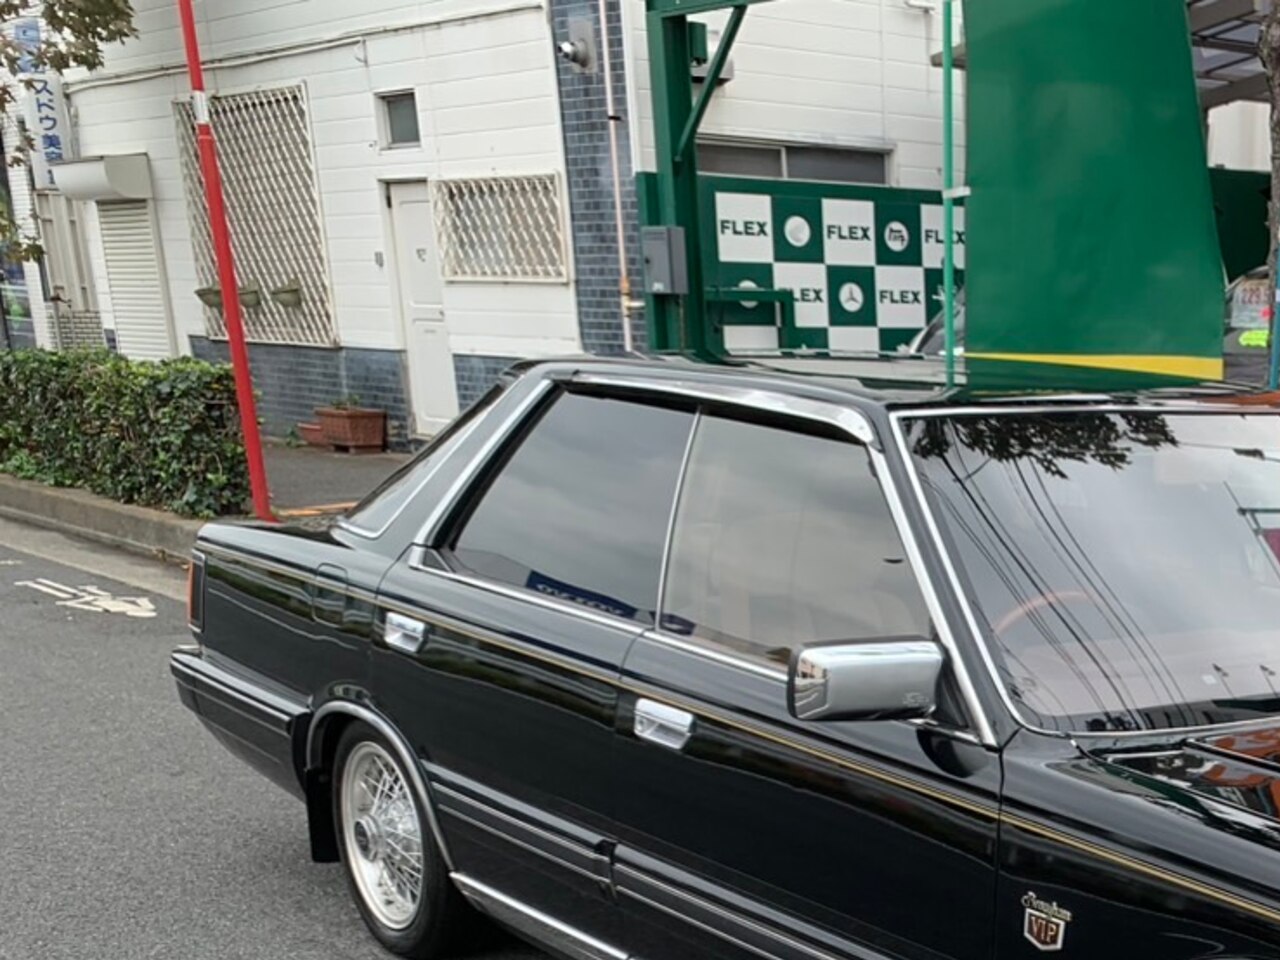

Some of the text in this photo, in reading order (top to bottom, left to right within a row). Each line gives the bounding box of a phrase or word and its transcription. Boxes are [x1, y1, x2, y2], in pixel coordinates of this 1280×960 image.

[720, 220, 768, 236] FLEX
[826, 224, 871, 241] FLEX
[925, 229, 965, 245] FLX
[794, 288, 825, 303] LEX
[879, 290, 922, 305] FLEX
[1030, 915, 1057, 943] VIP
